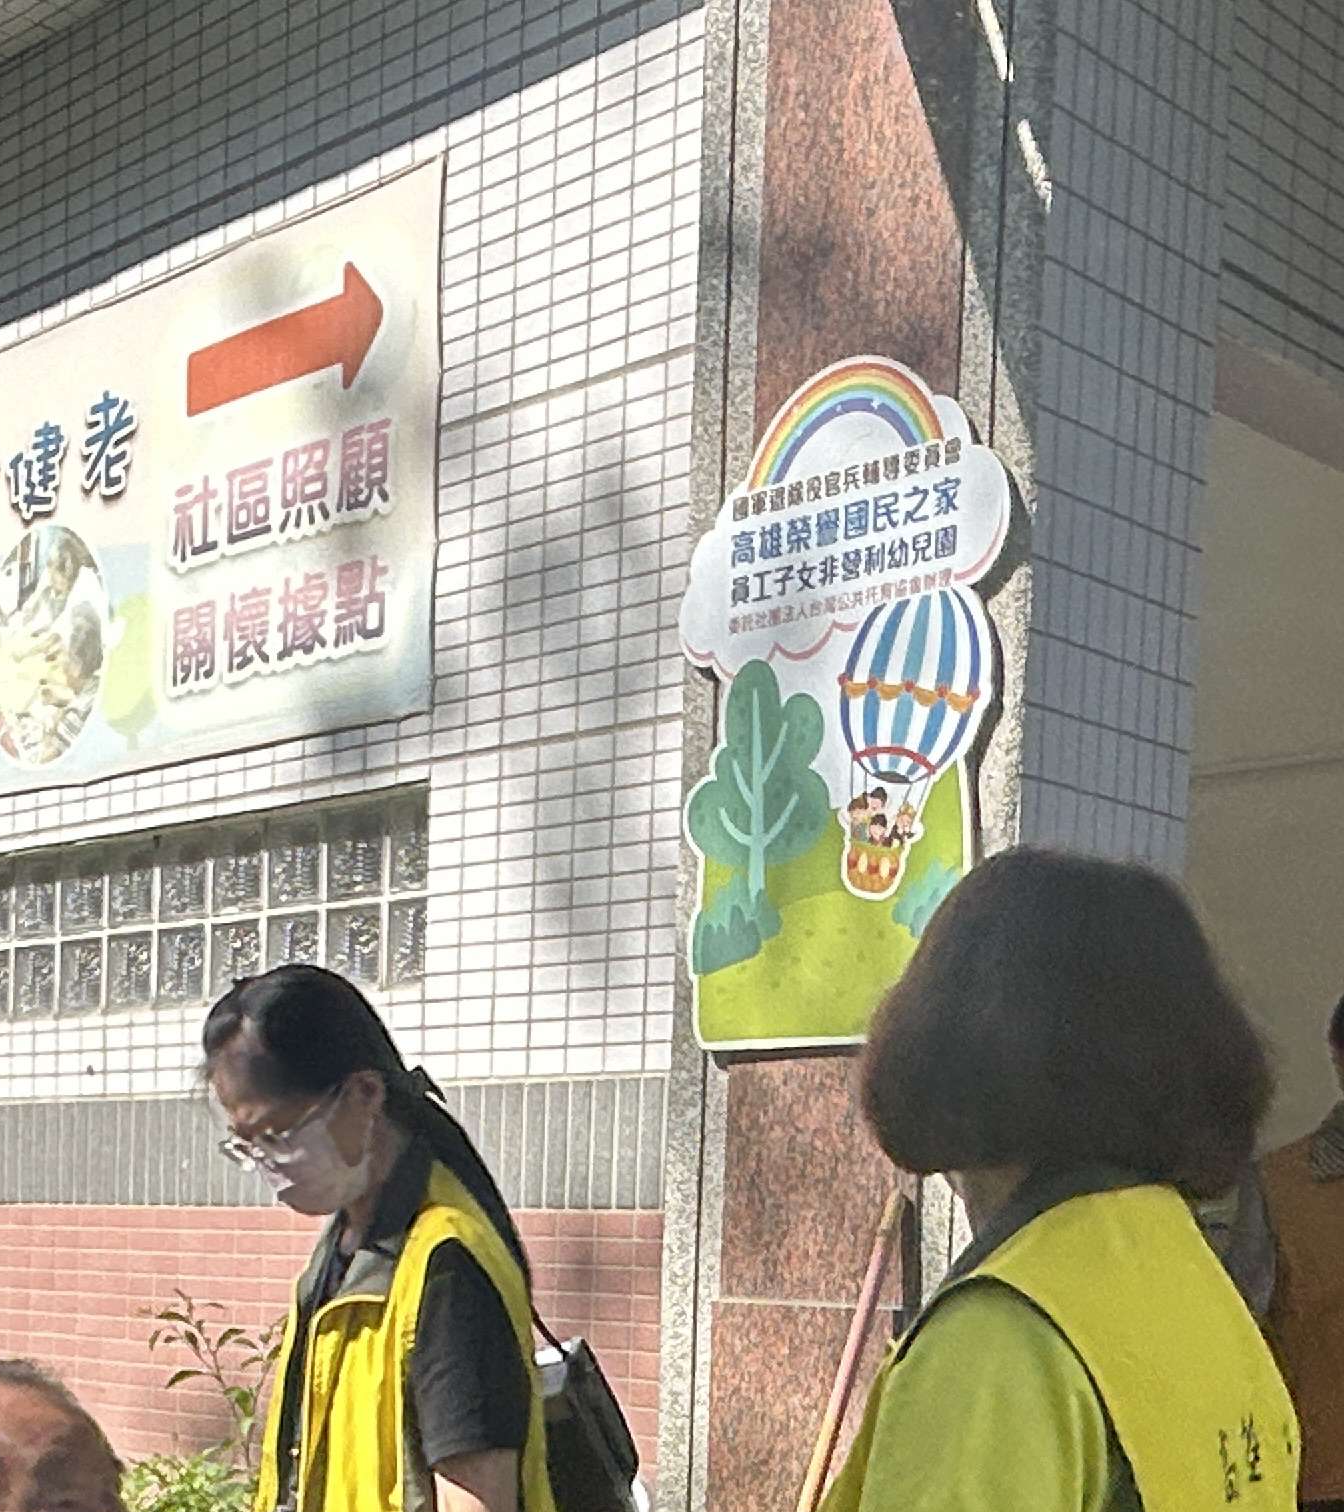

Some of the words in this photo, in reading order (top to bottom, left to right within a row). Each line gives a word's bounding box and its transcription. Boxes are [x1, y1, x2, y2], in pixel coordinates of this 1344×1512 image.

[173, 418, 392, 563] 社區照顧
[731, 477, 961, 567] 高雄榮譽國民之家
[173, 554, 389, 686] 關懷據點
[731, 525, 957, 607] 員工子女非營利幼兒園
